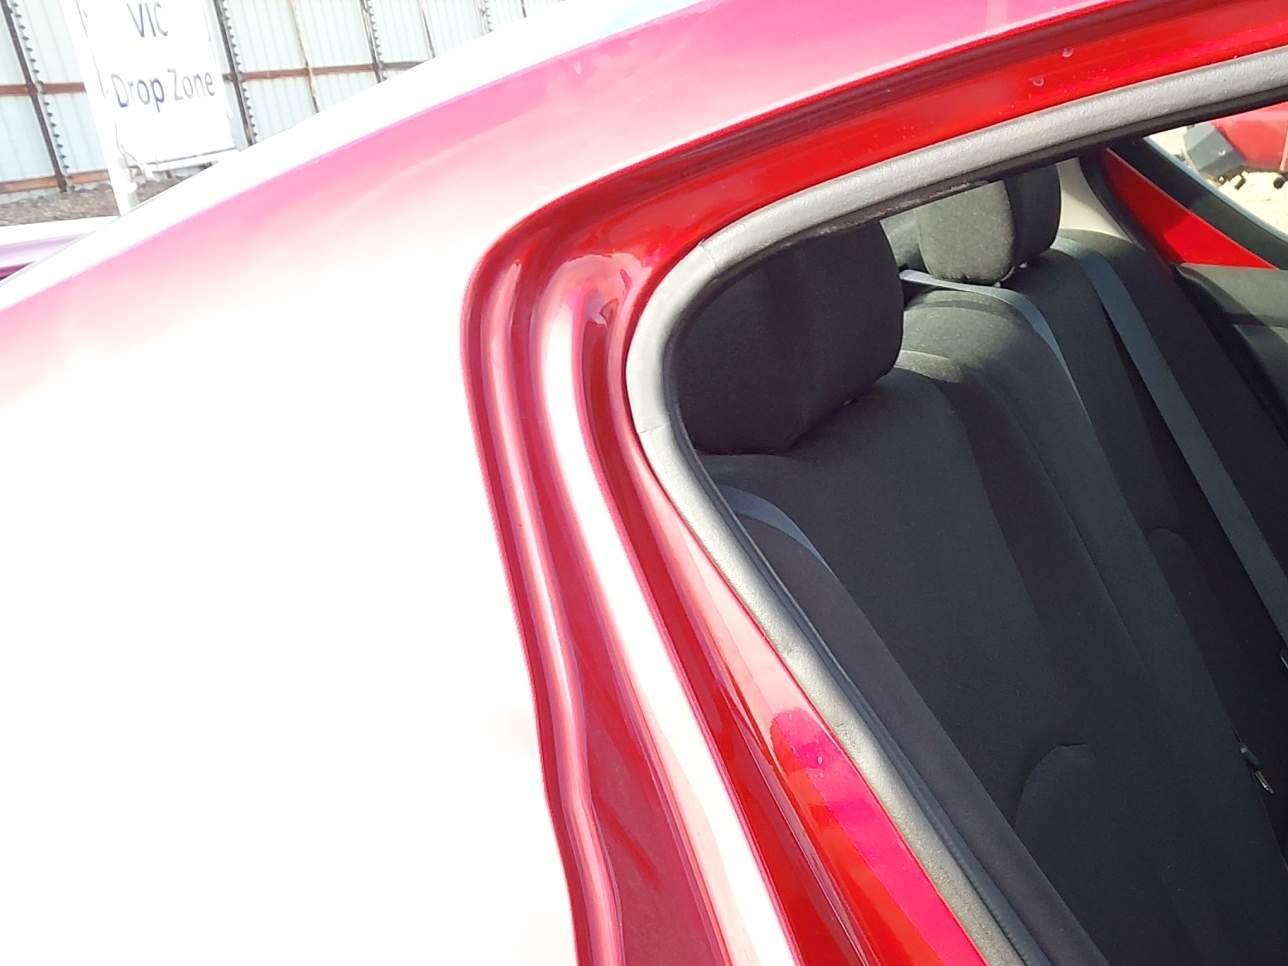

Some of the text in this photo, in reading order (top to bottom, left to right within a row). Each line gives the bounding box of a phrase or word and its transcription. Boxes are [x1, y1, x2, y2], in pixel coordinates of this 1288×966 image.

[125, 1, 169, 38] VIC
[110, 67, 216, 113] Drop Zone
